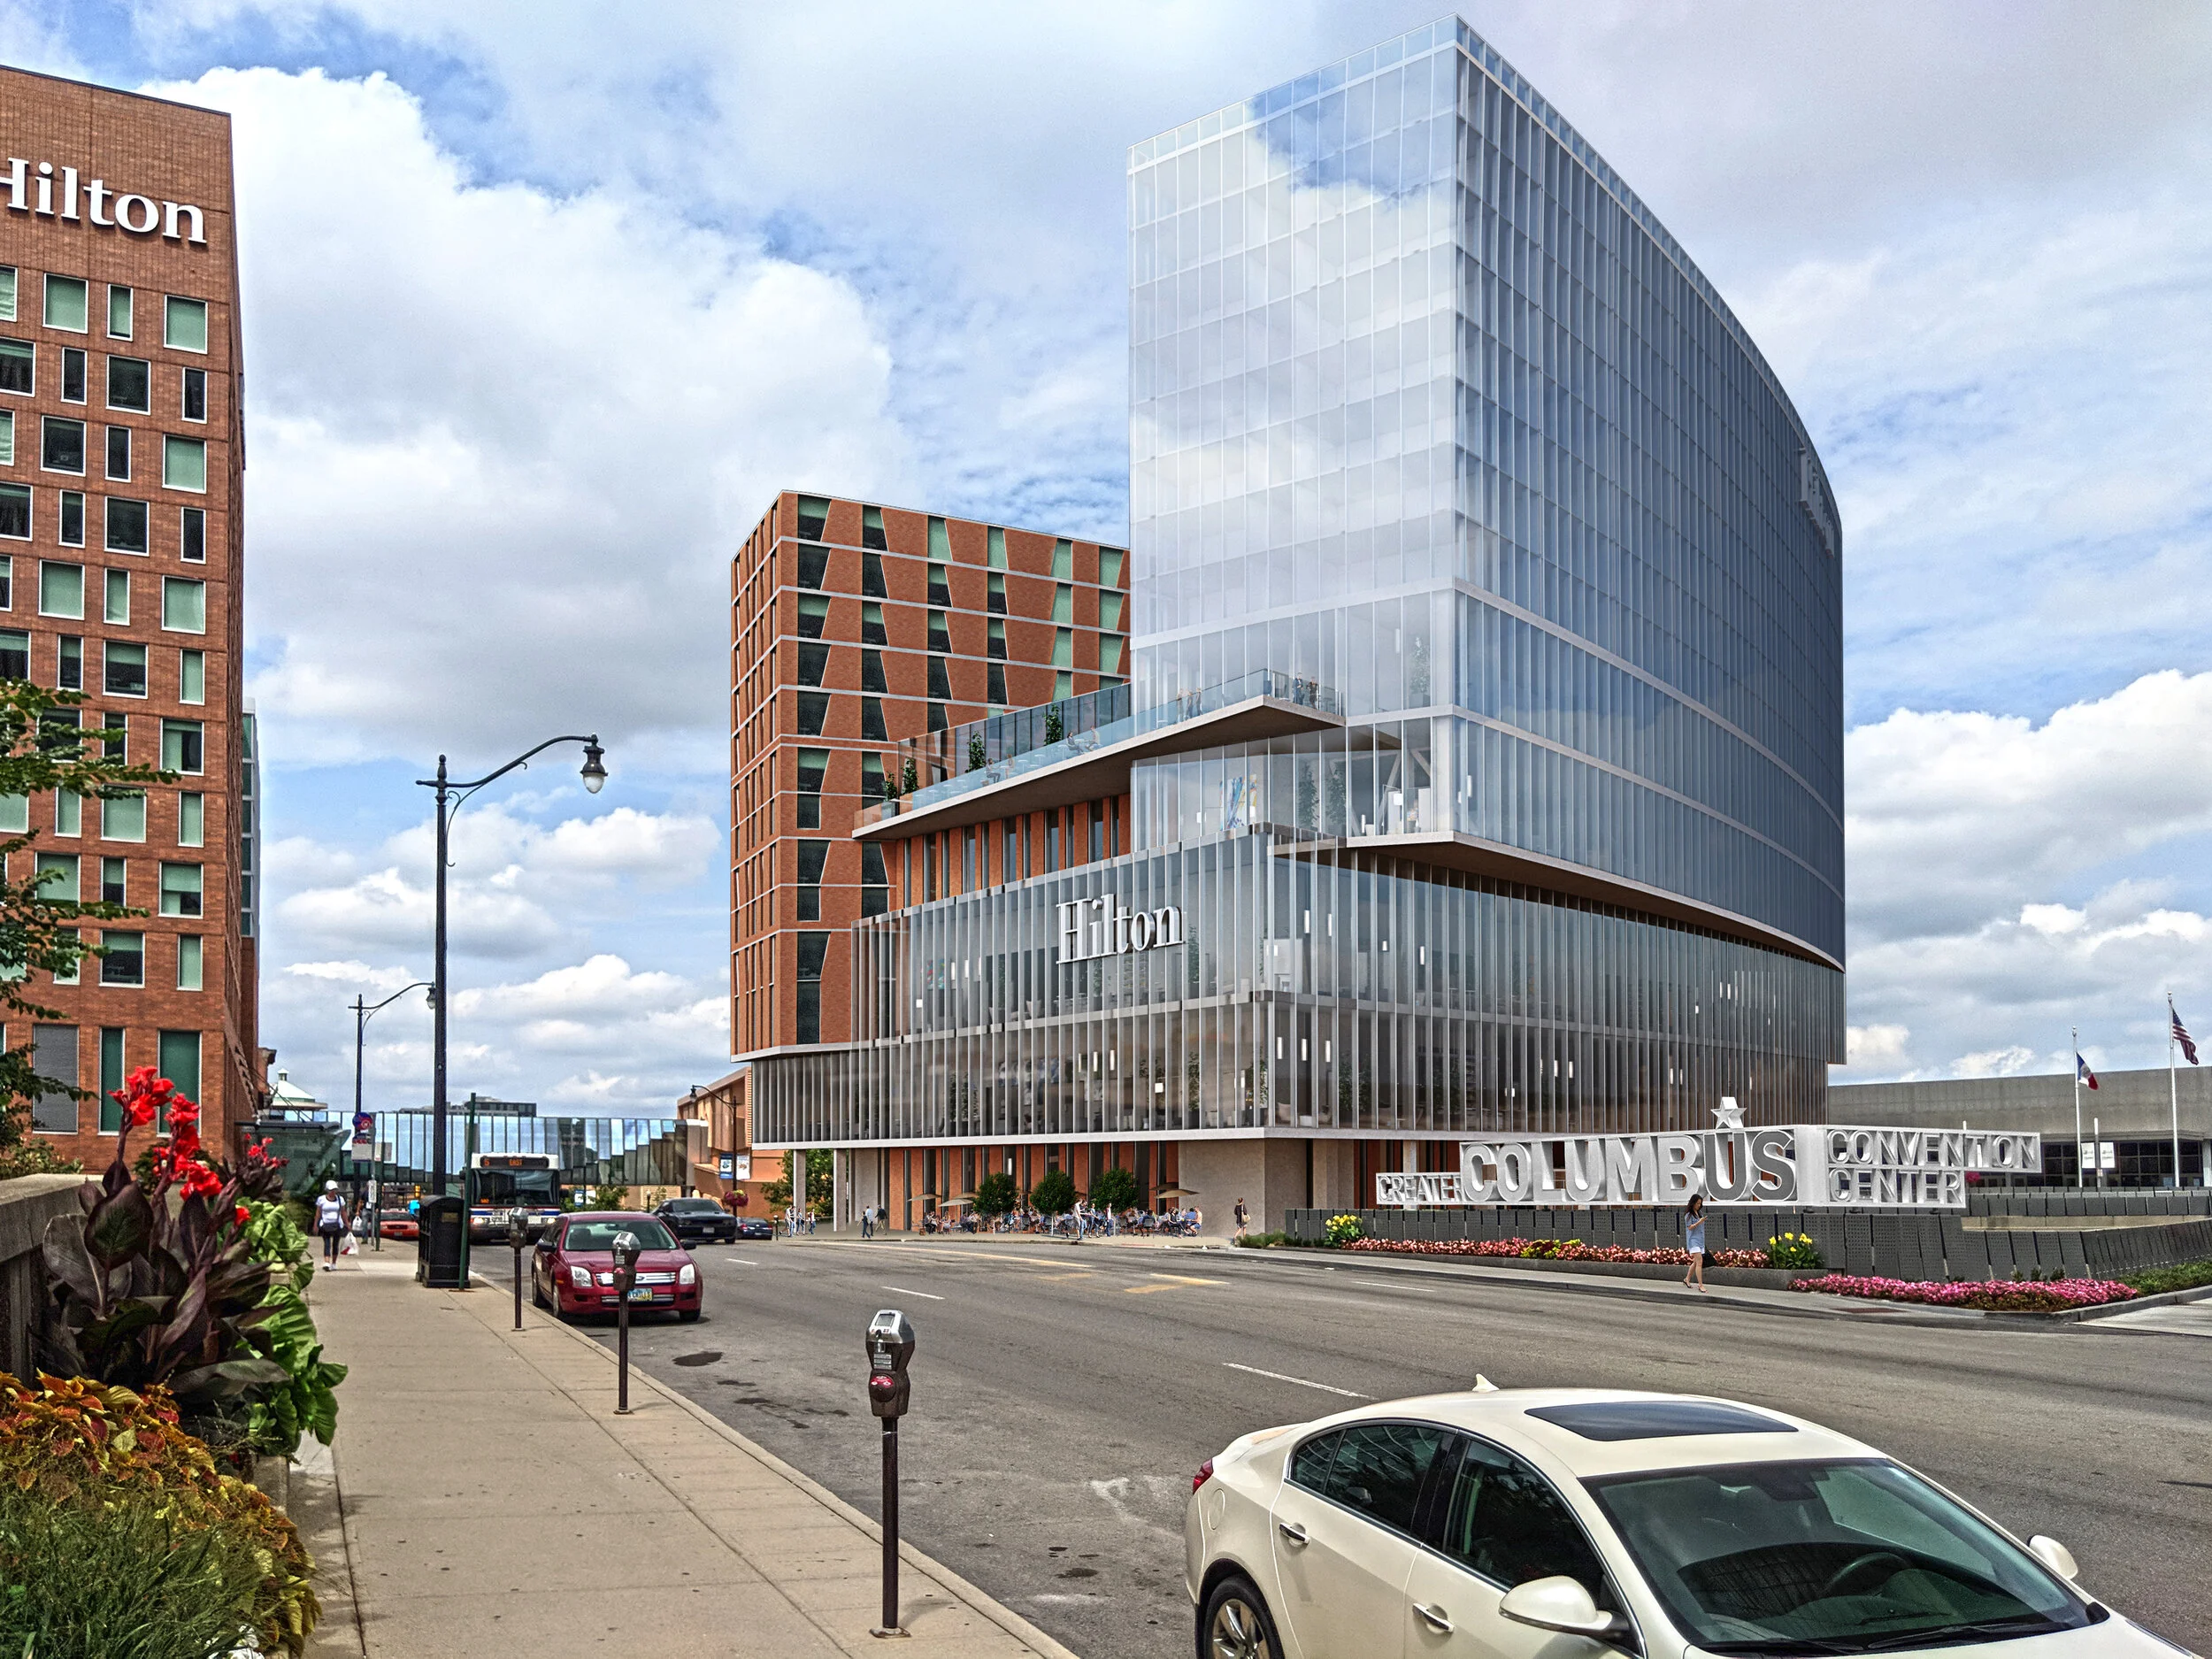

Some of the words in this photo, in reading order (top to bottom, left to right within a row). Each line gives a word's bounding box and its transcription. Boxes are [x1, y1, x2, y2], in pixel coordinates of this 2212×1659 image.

[0, 157, 207, 244] Hilton
[1056, 893, 1187, 964] Hilton
[1378, 1175, 1463, 1202] GREATER
[1462, 1130, 1797, 1202] COLUMBUS
[1827, 1129, 2039, 1169] CONVENTION
[1828, 1166, 1963, 1204] CENTER
